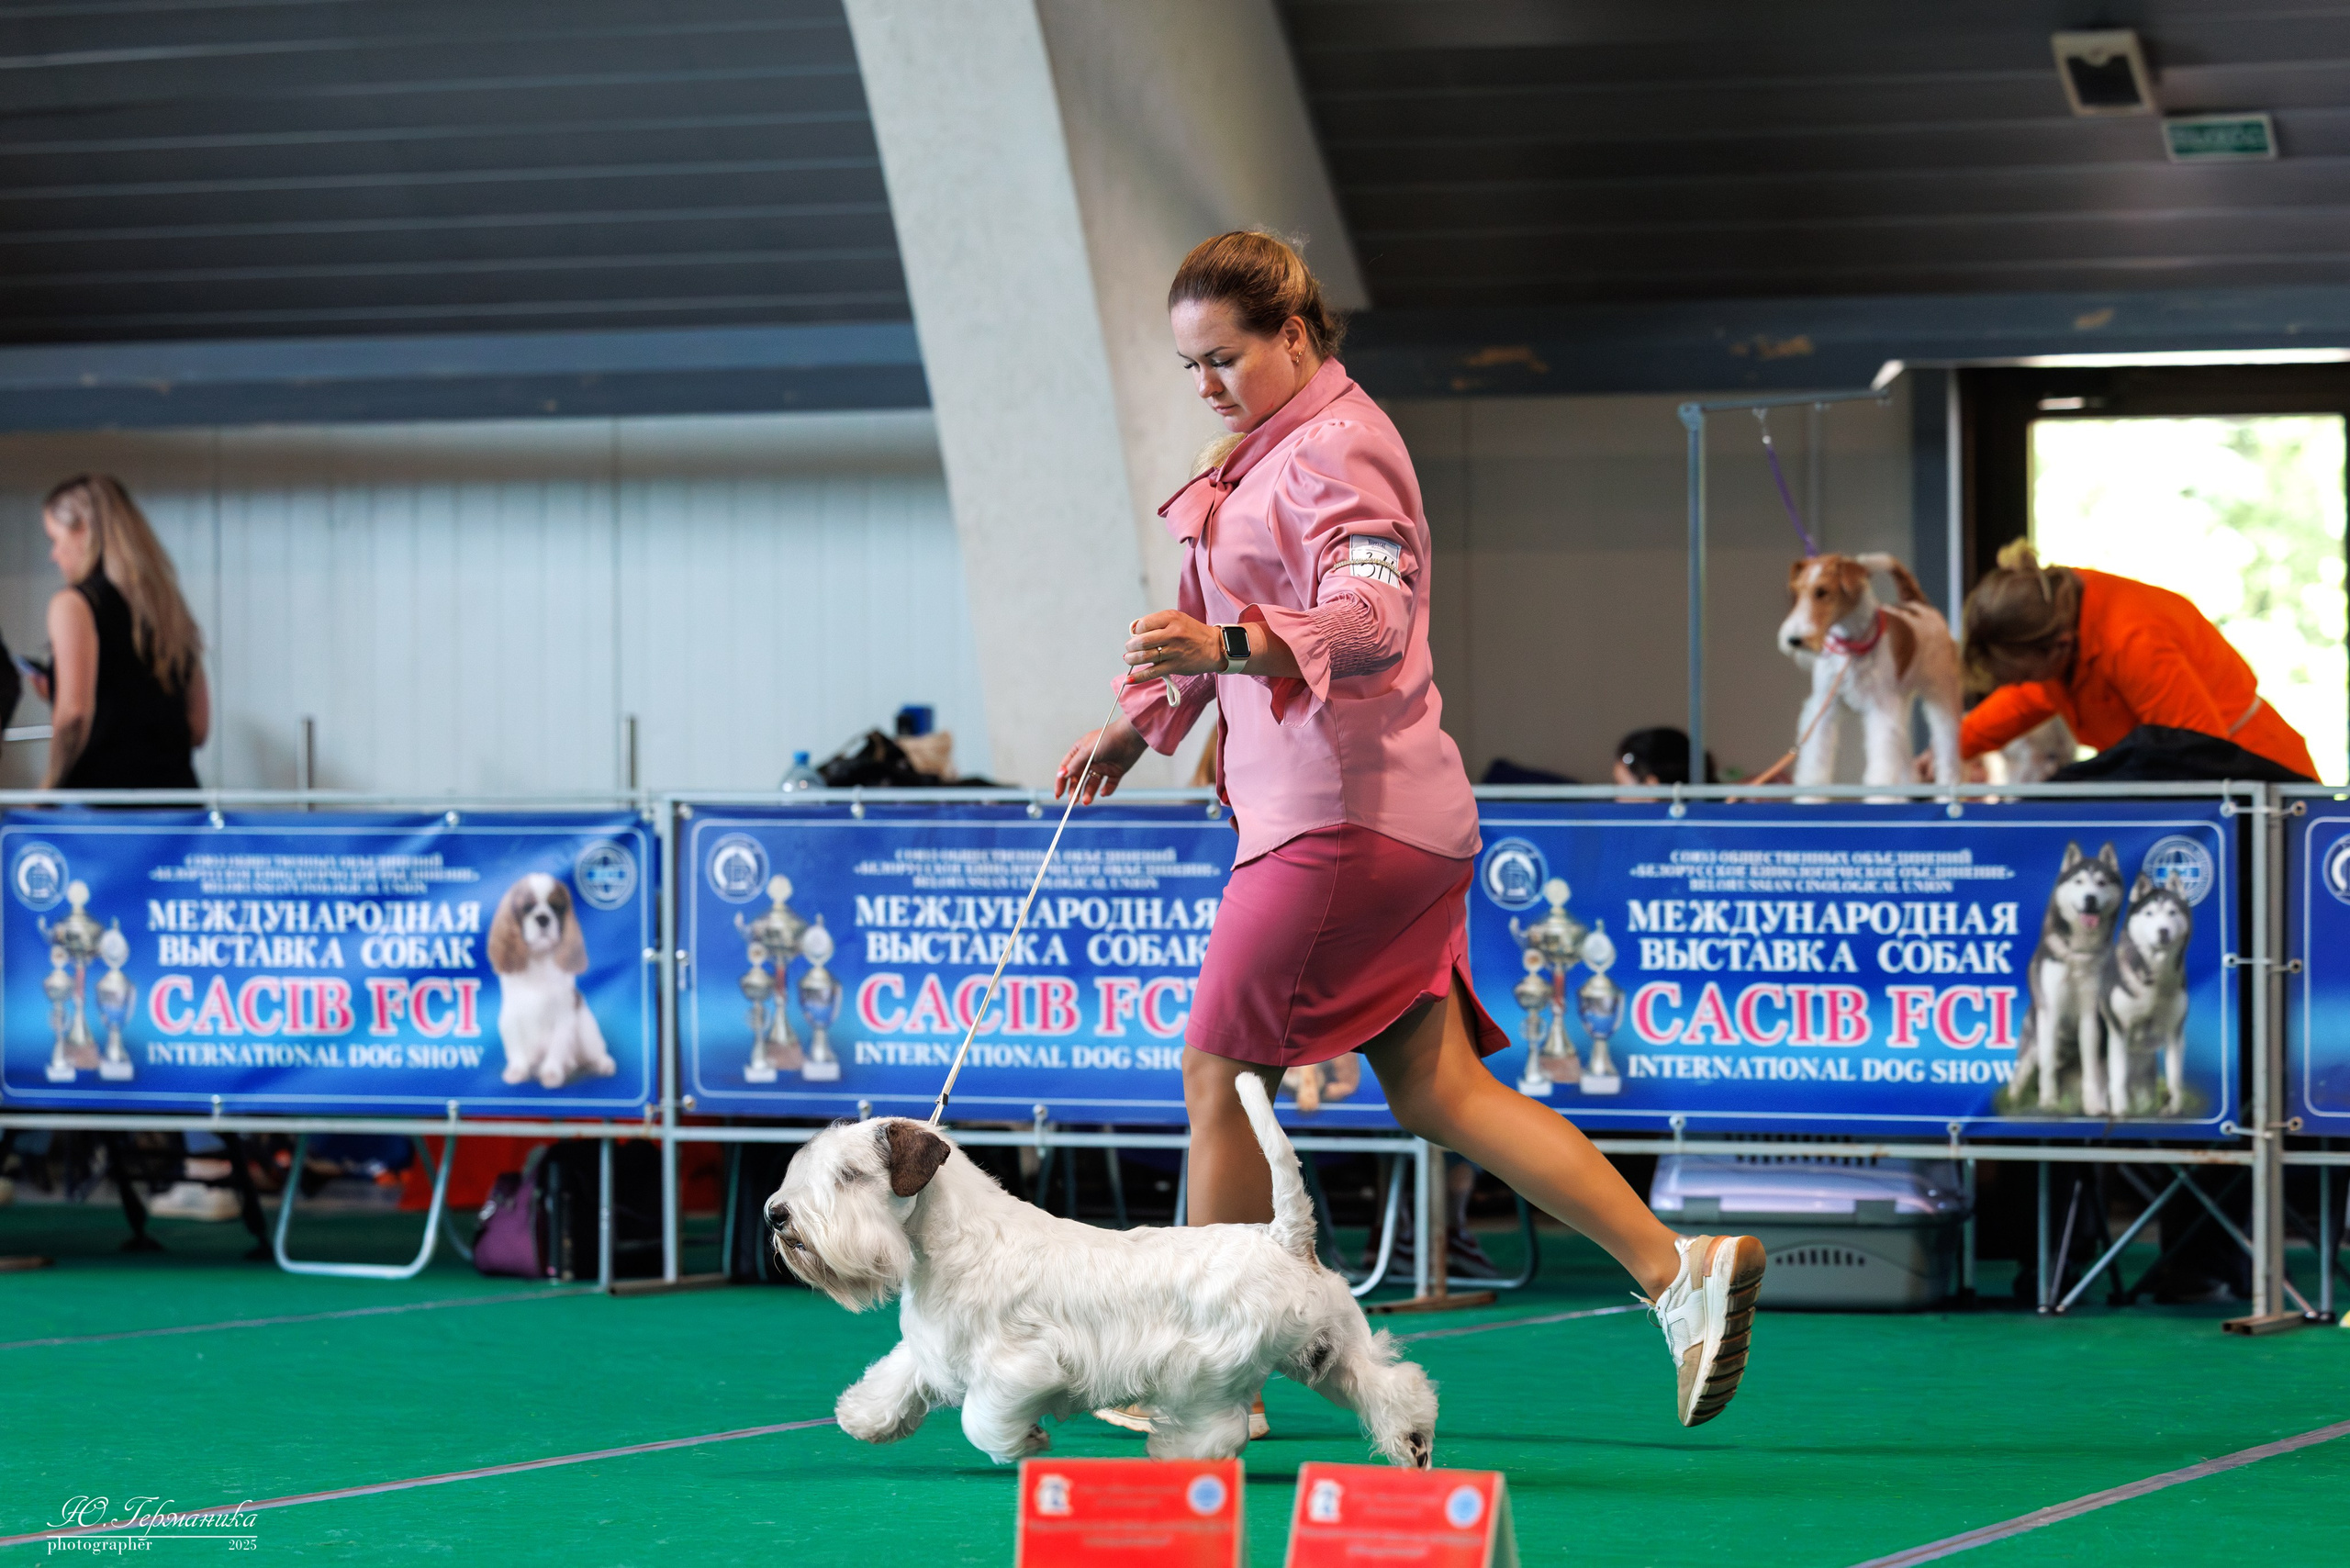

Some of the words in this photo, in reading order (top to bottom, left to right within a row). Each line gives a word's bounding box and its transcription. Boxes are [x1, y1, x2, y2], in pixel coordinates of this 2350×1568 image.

[147, 899, 481, 935] МЕЖДУНАРОДНАЯ
[854, 895, 1219, 932] МЕЖДУНАРОДНАЯ
[1627, 899, 2019, 938] МЕЖДУНАРОДНАЯ
[158, 935, 346, 969] ВЫСТАВКА
[360, 936, 476, 969] СОБАК
[866, 931, 1070, 965] ВЫСТАВКА
[1086, 935, 1209, 966] СОБАК
[1639, 937, 1859, 972] ВЫСТАВКА
[1877, 940, 2013, 974] СОБАК
[149, 974, 356, 1036] CACIB
[365, 977, 482, 1038] FCI
[856, 972, 1082, 1036] CACIB
[1094, 976, 1199, 1037] FC
[1631, 981, 1873, 1047] CACIB
[1886, 984, 2018, 1049] FCI
[147, 1042, 344, 1069] INTERNATIONAL
[348, 1045, 404, 1069] DOG
[406, 1045, 485, 1070] SHOW
[854, 1041, 1066, 1070] INTERNATIONAL
[1072, 1045, 1131, 1070] DOG
[1627, 1055, 1856, 1081] INTERNATIONAL
[1861, 1058, 1924, 1083] DOG
[1930, 1058, 2018, 1084] SHOW
